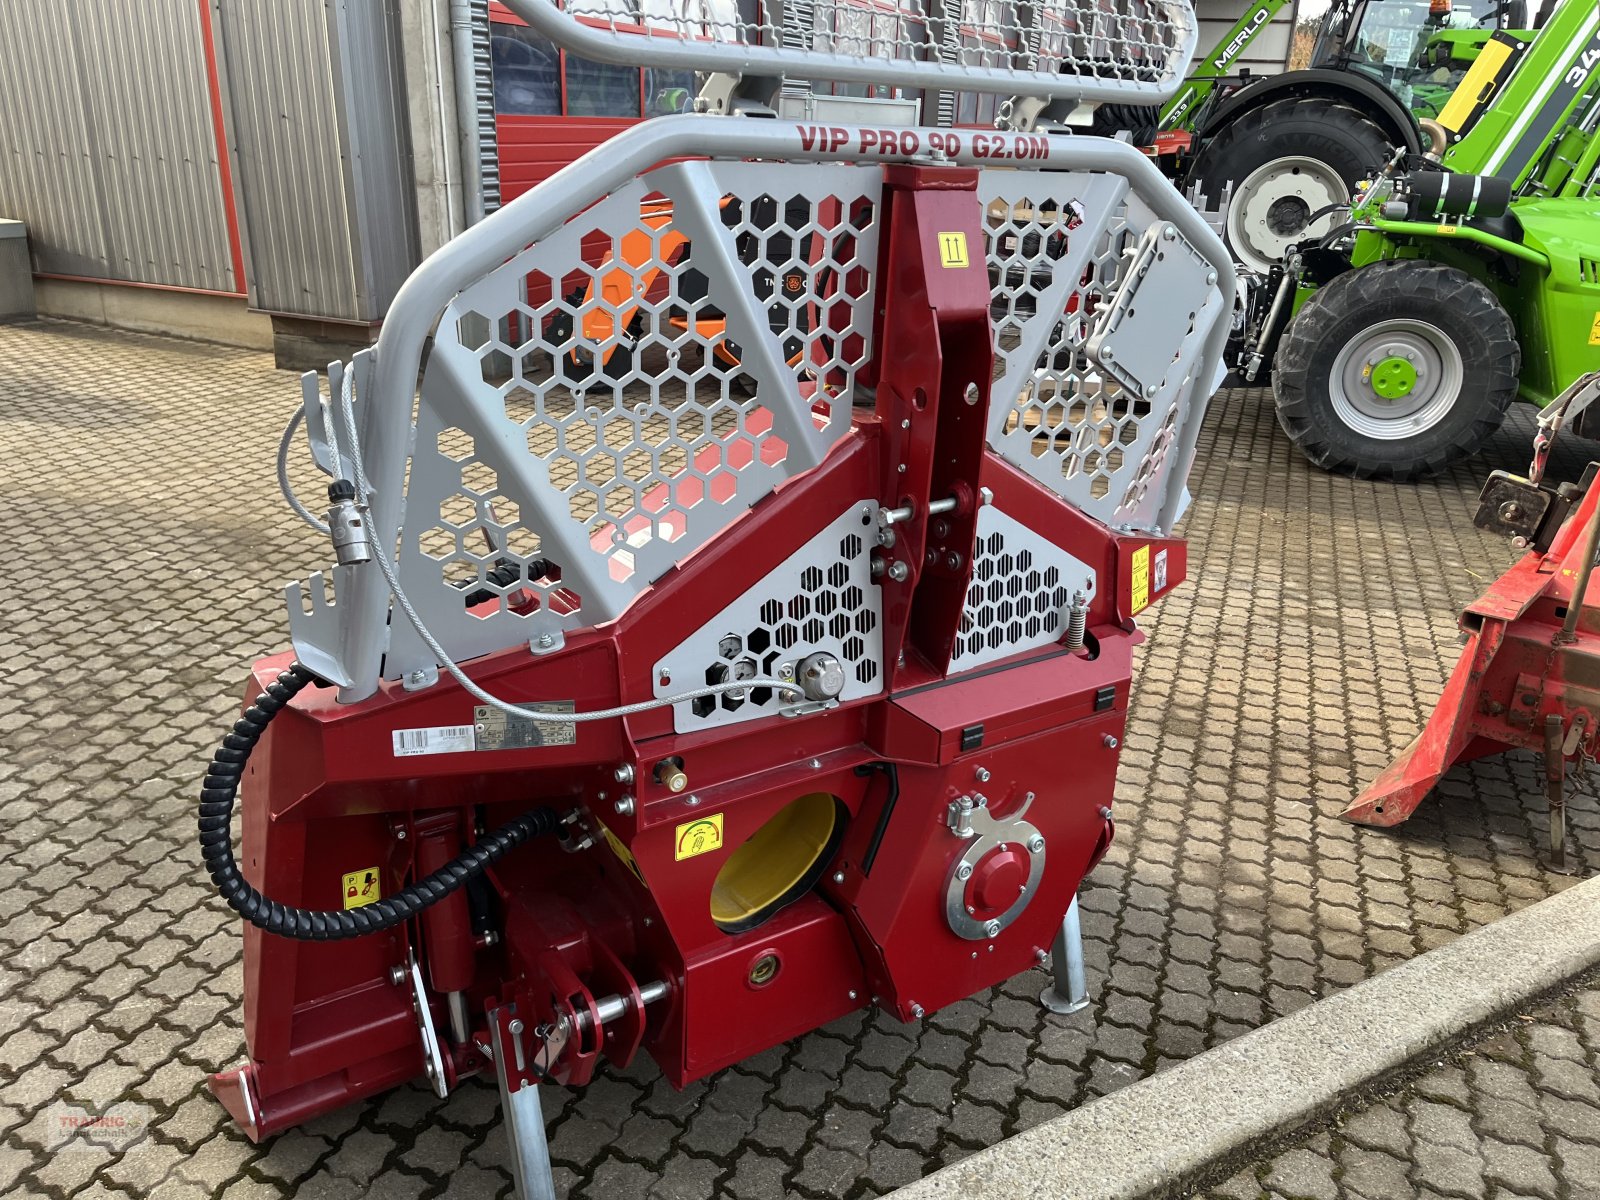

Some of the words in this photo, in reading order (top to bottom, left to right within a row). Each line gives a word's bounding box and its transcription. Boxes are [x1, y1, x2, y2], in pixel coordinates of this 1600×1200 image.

[1214, 8, 1268, 69] MERLO
[1170, 103, 1188, 123] 33.9
[795, 125, 850, 153] VIP
[858, 128, 920, 156] PRO
[928, 132, 960, 158] 90
[972, 134, 1050, 160] G2.0M
